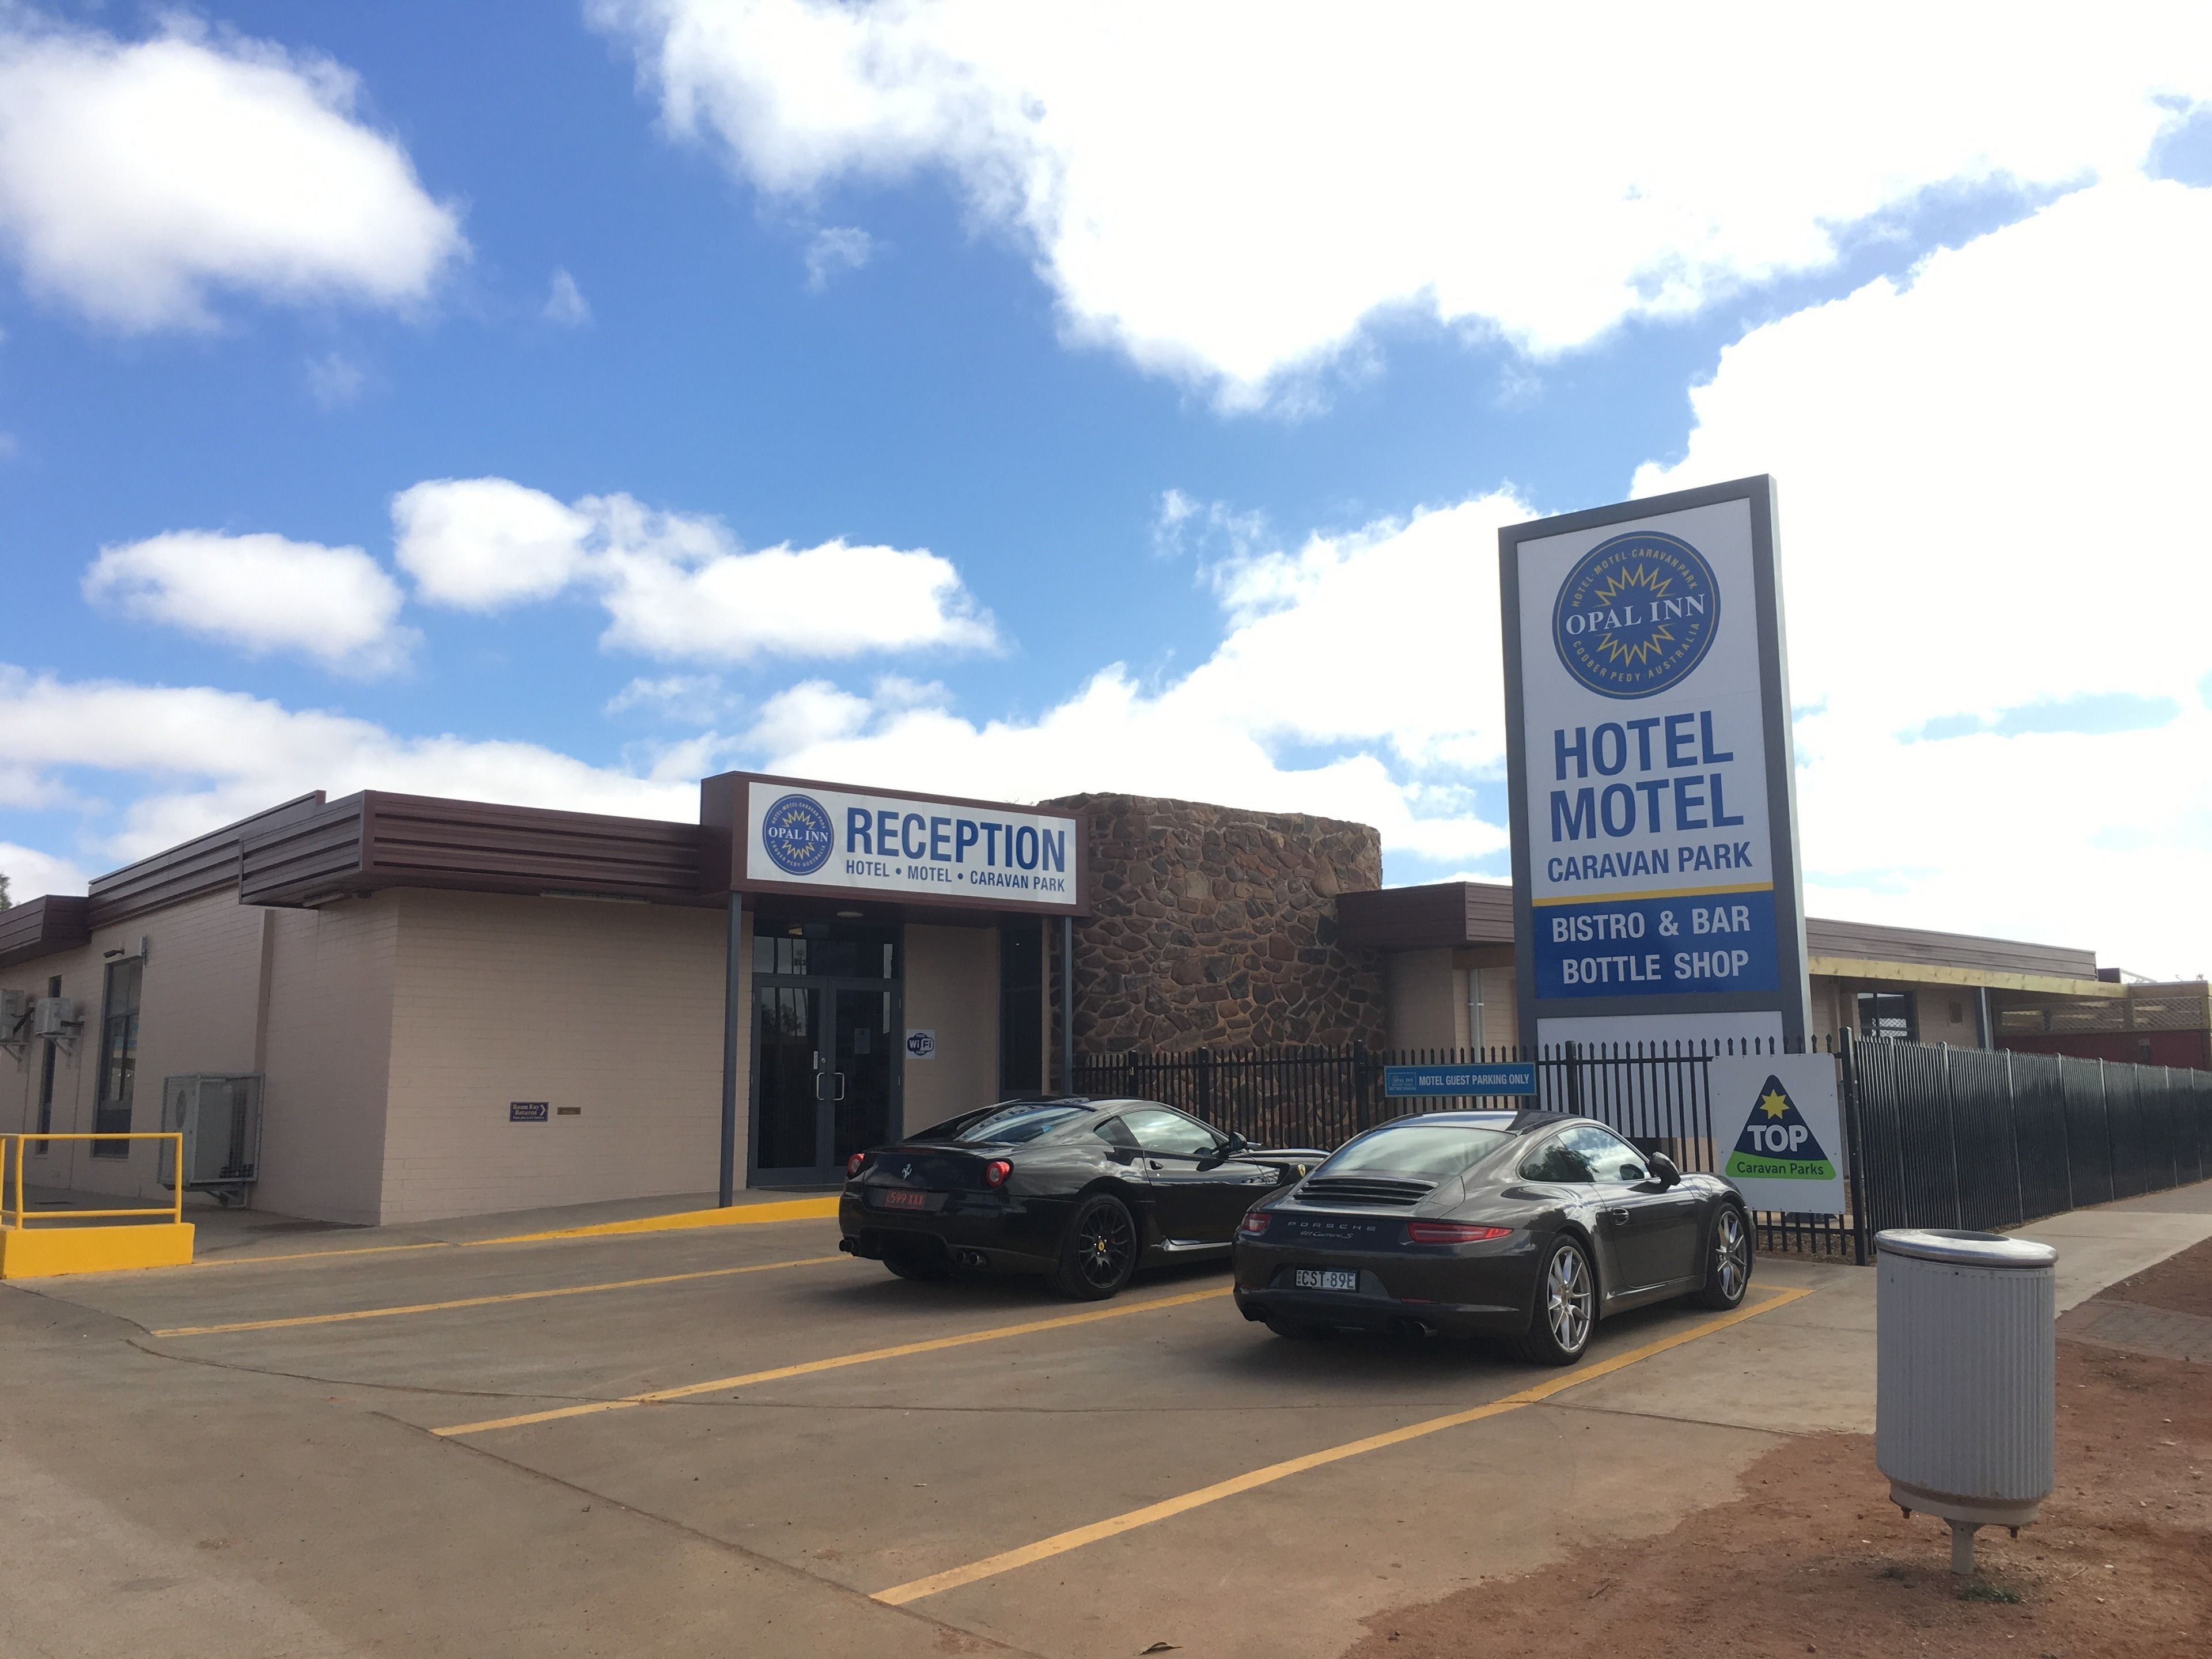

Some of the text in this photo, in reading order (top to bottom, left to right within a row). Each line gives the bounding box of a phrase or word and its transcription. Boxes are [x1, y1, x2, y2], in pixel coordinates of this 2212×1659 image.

[1571, 548, 1698, 608] HOTEL MOTEL CARAVAN PARK
[1566, 593, 1705, 635] OPAL INN
[1573, 623, 1700, 683] COOBER PEDY AUSTRALIA
[1554, 710, 1734, 781] HOTEL
[1550, 773, 1744, 842] MOTEL
[768, 827, 828, 843] OPAL INN
[846, 806, 1065, 873] RECEPTION
[846, 859, 1065, 892] HOTEL MOTEL CARAVAN PARK
[1548, 842, 1753, 882] CARAVAN PARK
[1552, 905, 1751, 943] BISTRO & BAR
[1562, 949, 1749, 984] BOTTLE SHOP
[1419, 1074, 1530, 1086] MOTEL GUEST PARKING ONLY
[1747, 1124, 1808, 1152] TOP
[1737, 1161, 1824, 1175] Caravan Parks
[1287, 1221, 1376, 1231] PORSCHE
